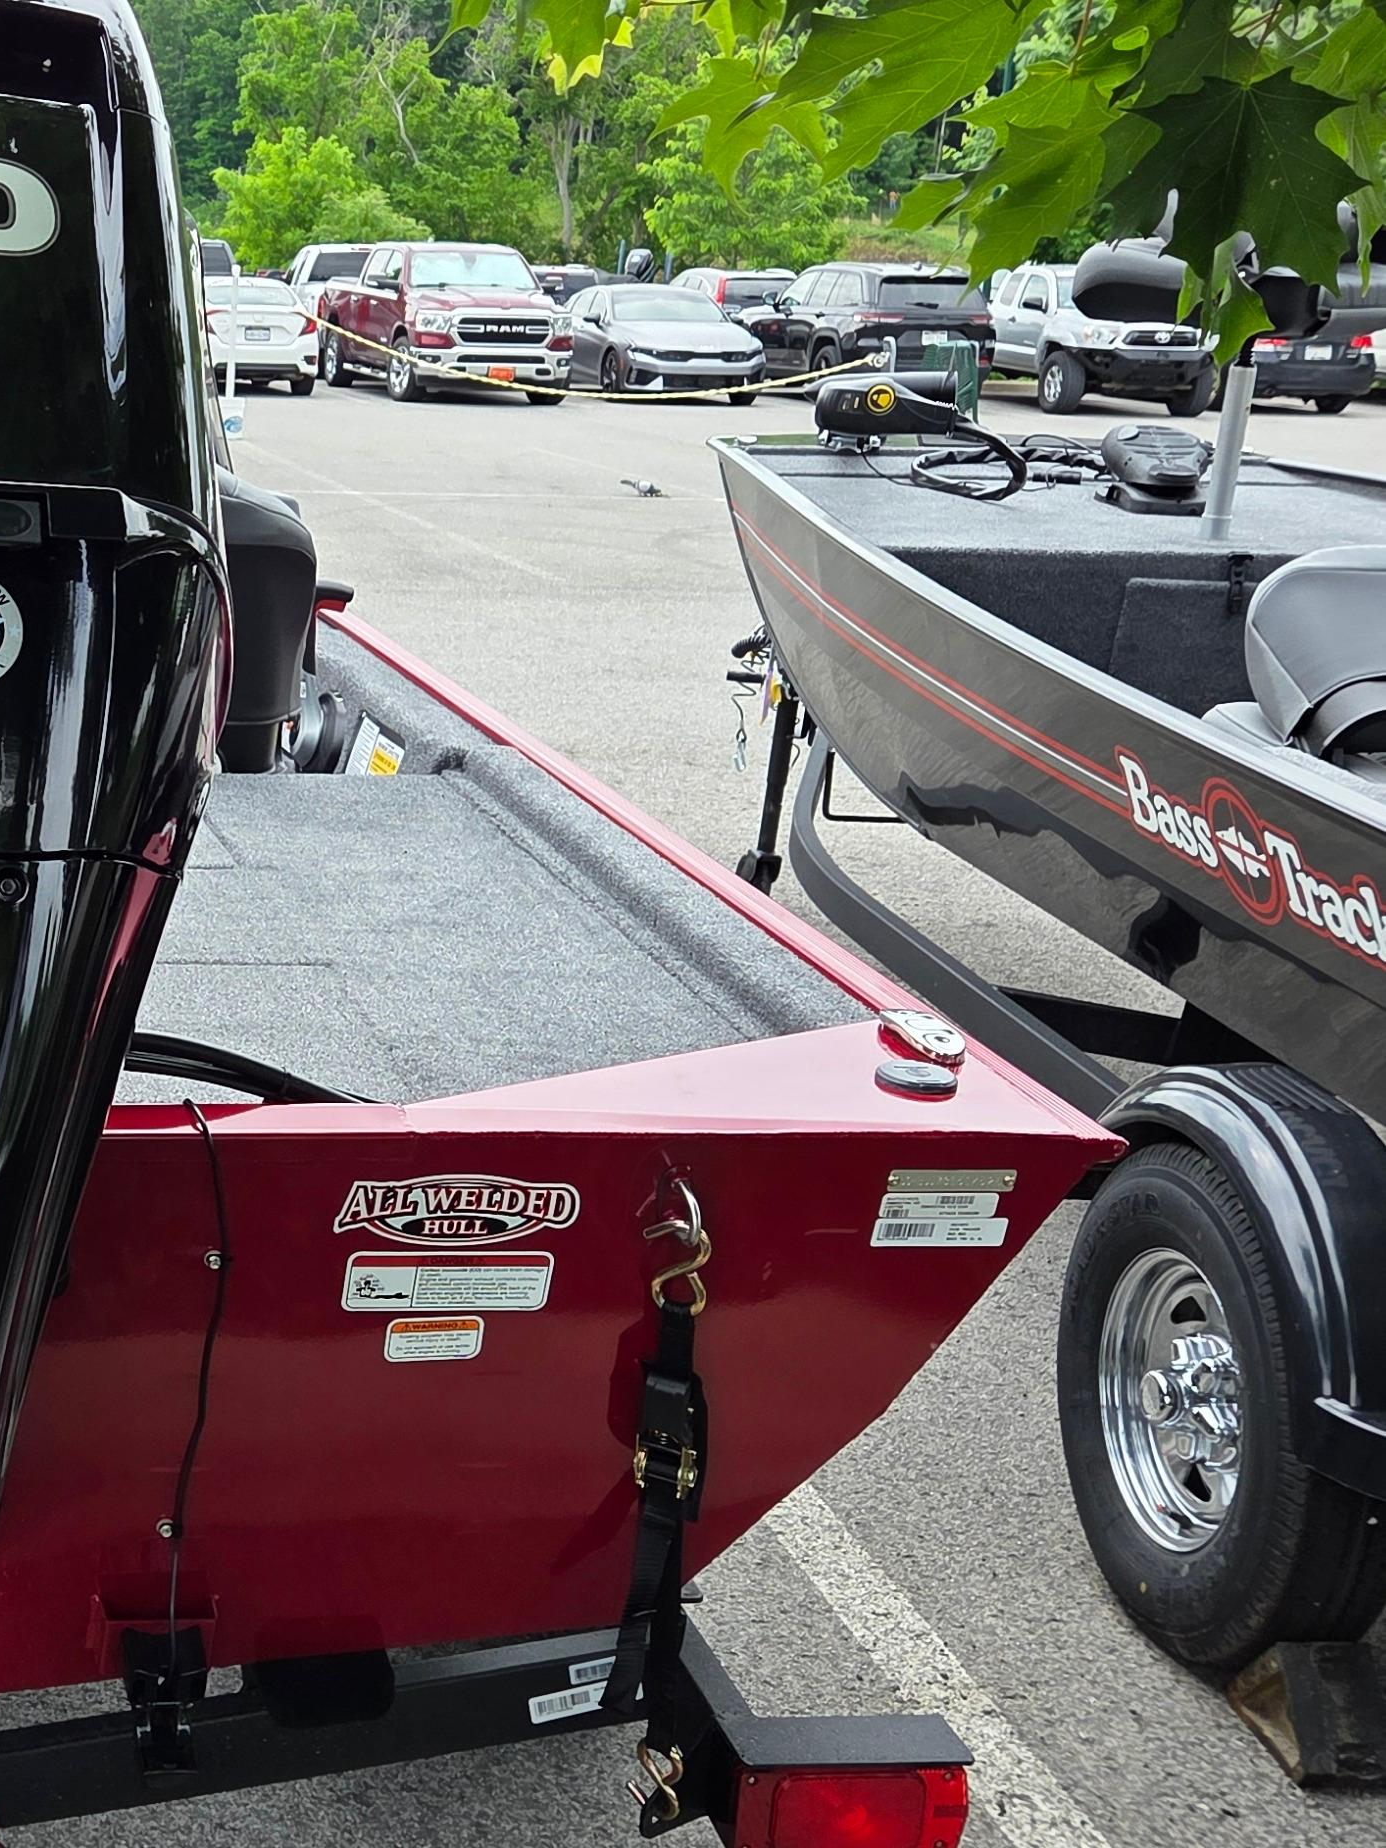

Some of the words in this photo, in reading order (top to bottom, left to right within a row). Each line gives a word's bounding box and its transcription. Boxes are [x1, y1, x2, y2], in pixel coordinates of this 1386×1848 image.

[485, 324, 525, 333] RAM
[1118, 754, 1220, 869] Bass
[341, 1185, 415, 1224] ALL
[424, 1185, 574, 1225] WELDED
[421, 1218, 489, 1235] HULL
[412, 1322, 459, 1332] WARNING
